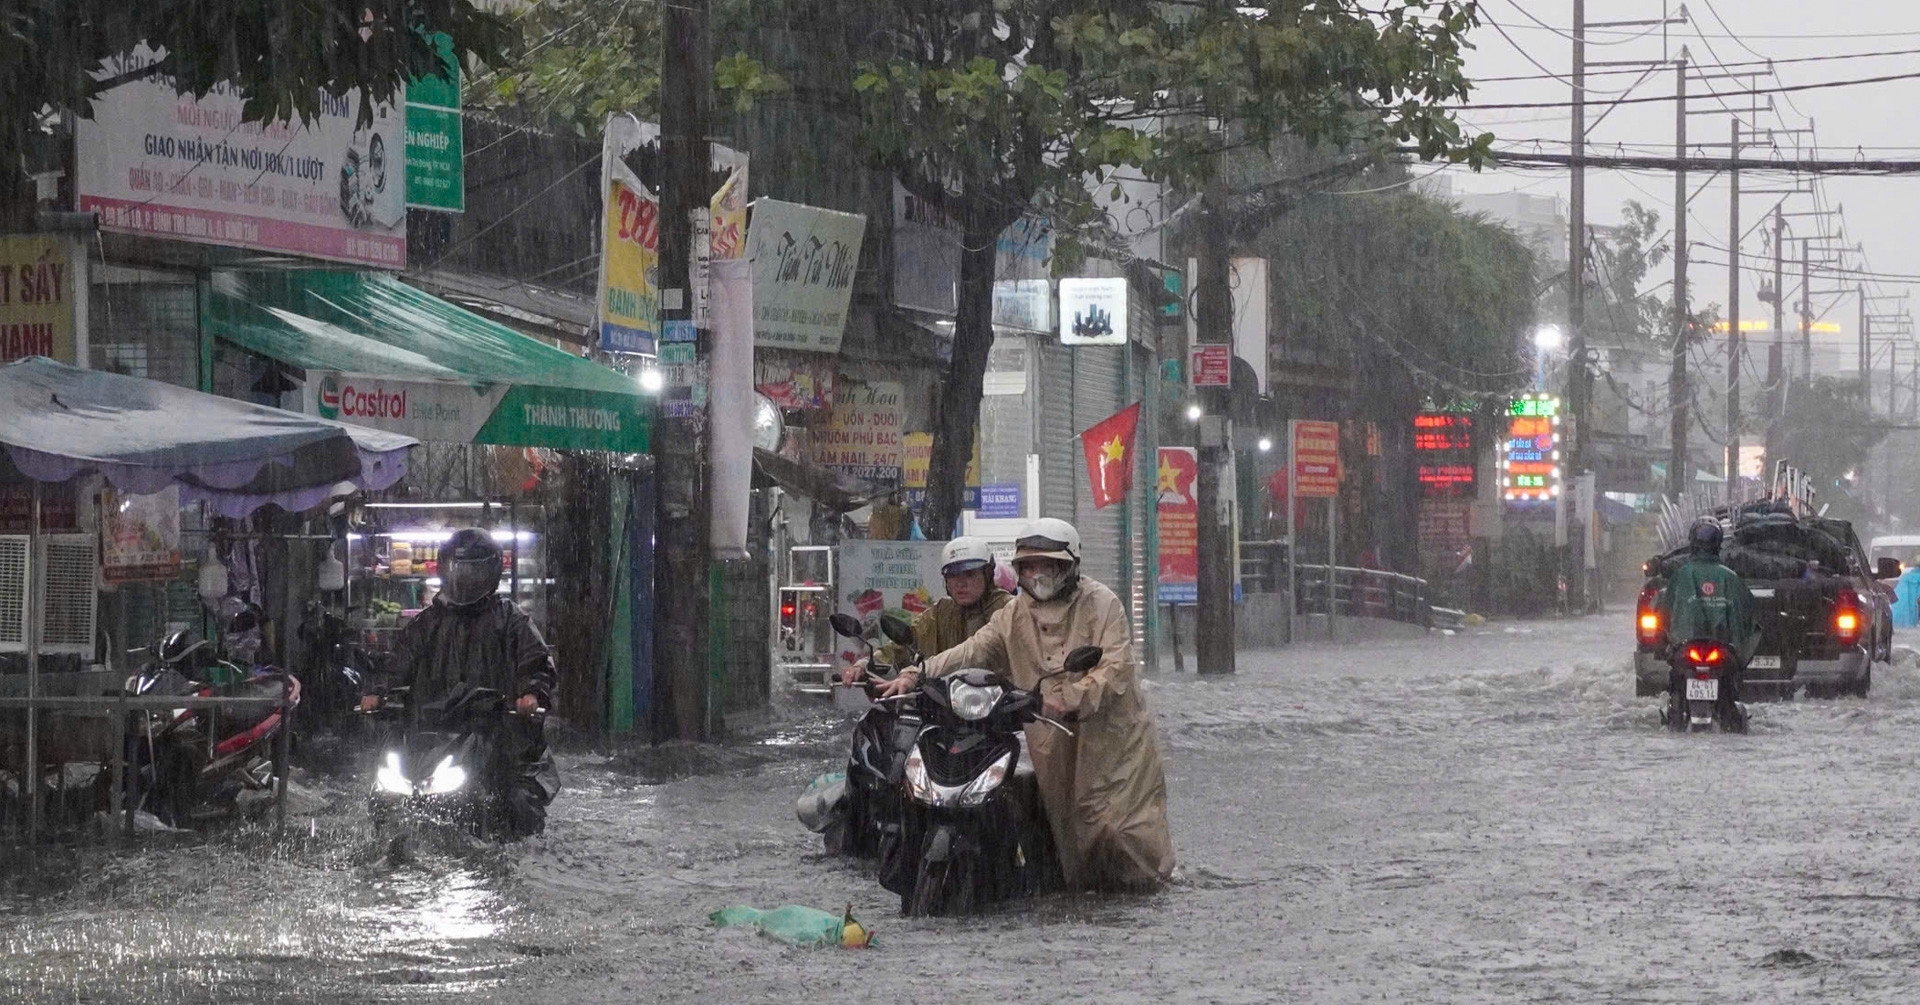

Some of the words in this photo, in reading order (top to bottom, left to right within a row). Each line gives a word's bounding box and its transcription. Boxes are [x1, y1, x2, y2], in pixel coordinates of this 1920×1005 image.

[416, 130, 450, 153] NGHIỆP
[144, 133, 175, 159] GIAO
[215, 138, 238, 173] TẬN
[297, 158, 324, 187] LƯỢT
[20, 248, 64, 305] SẤY
[341, 386, 406, 418] Castrol
[523, 400, 567, 428] THÀNH
[568, 406, 620, 432] THƯƠNG
[876, 430, 898, 449] BẠC
[873, 452, 898, 466] 24/7
